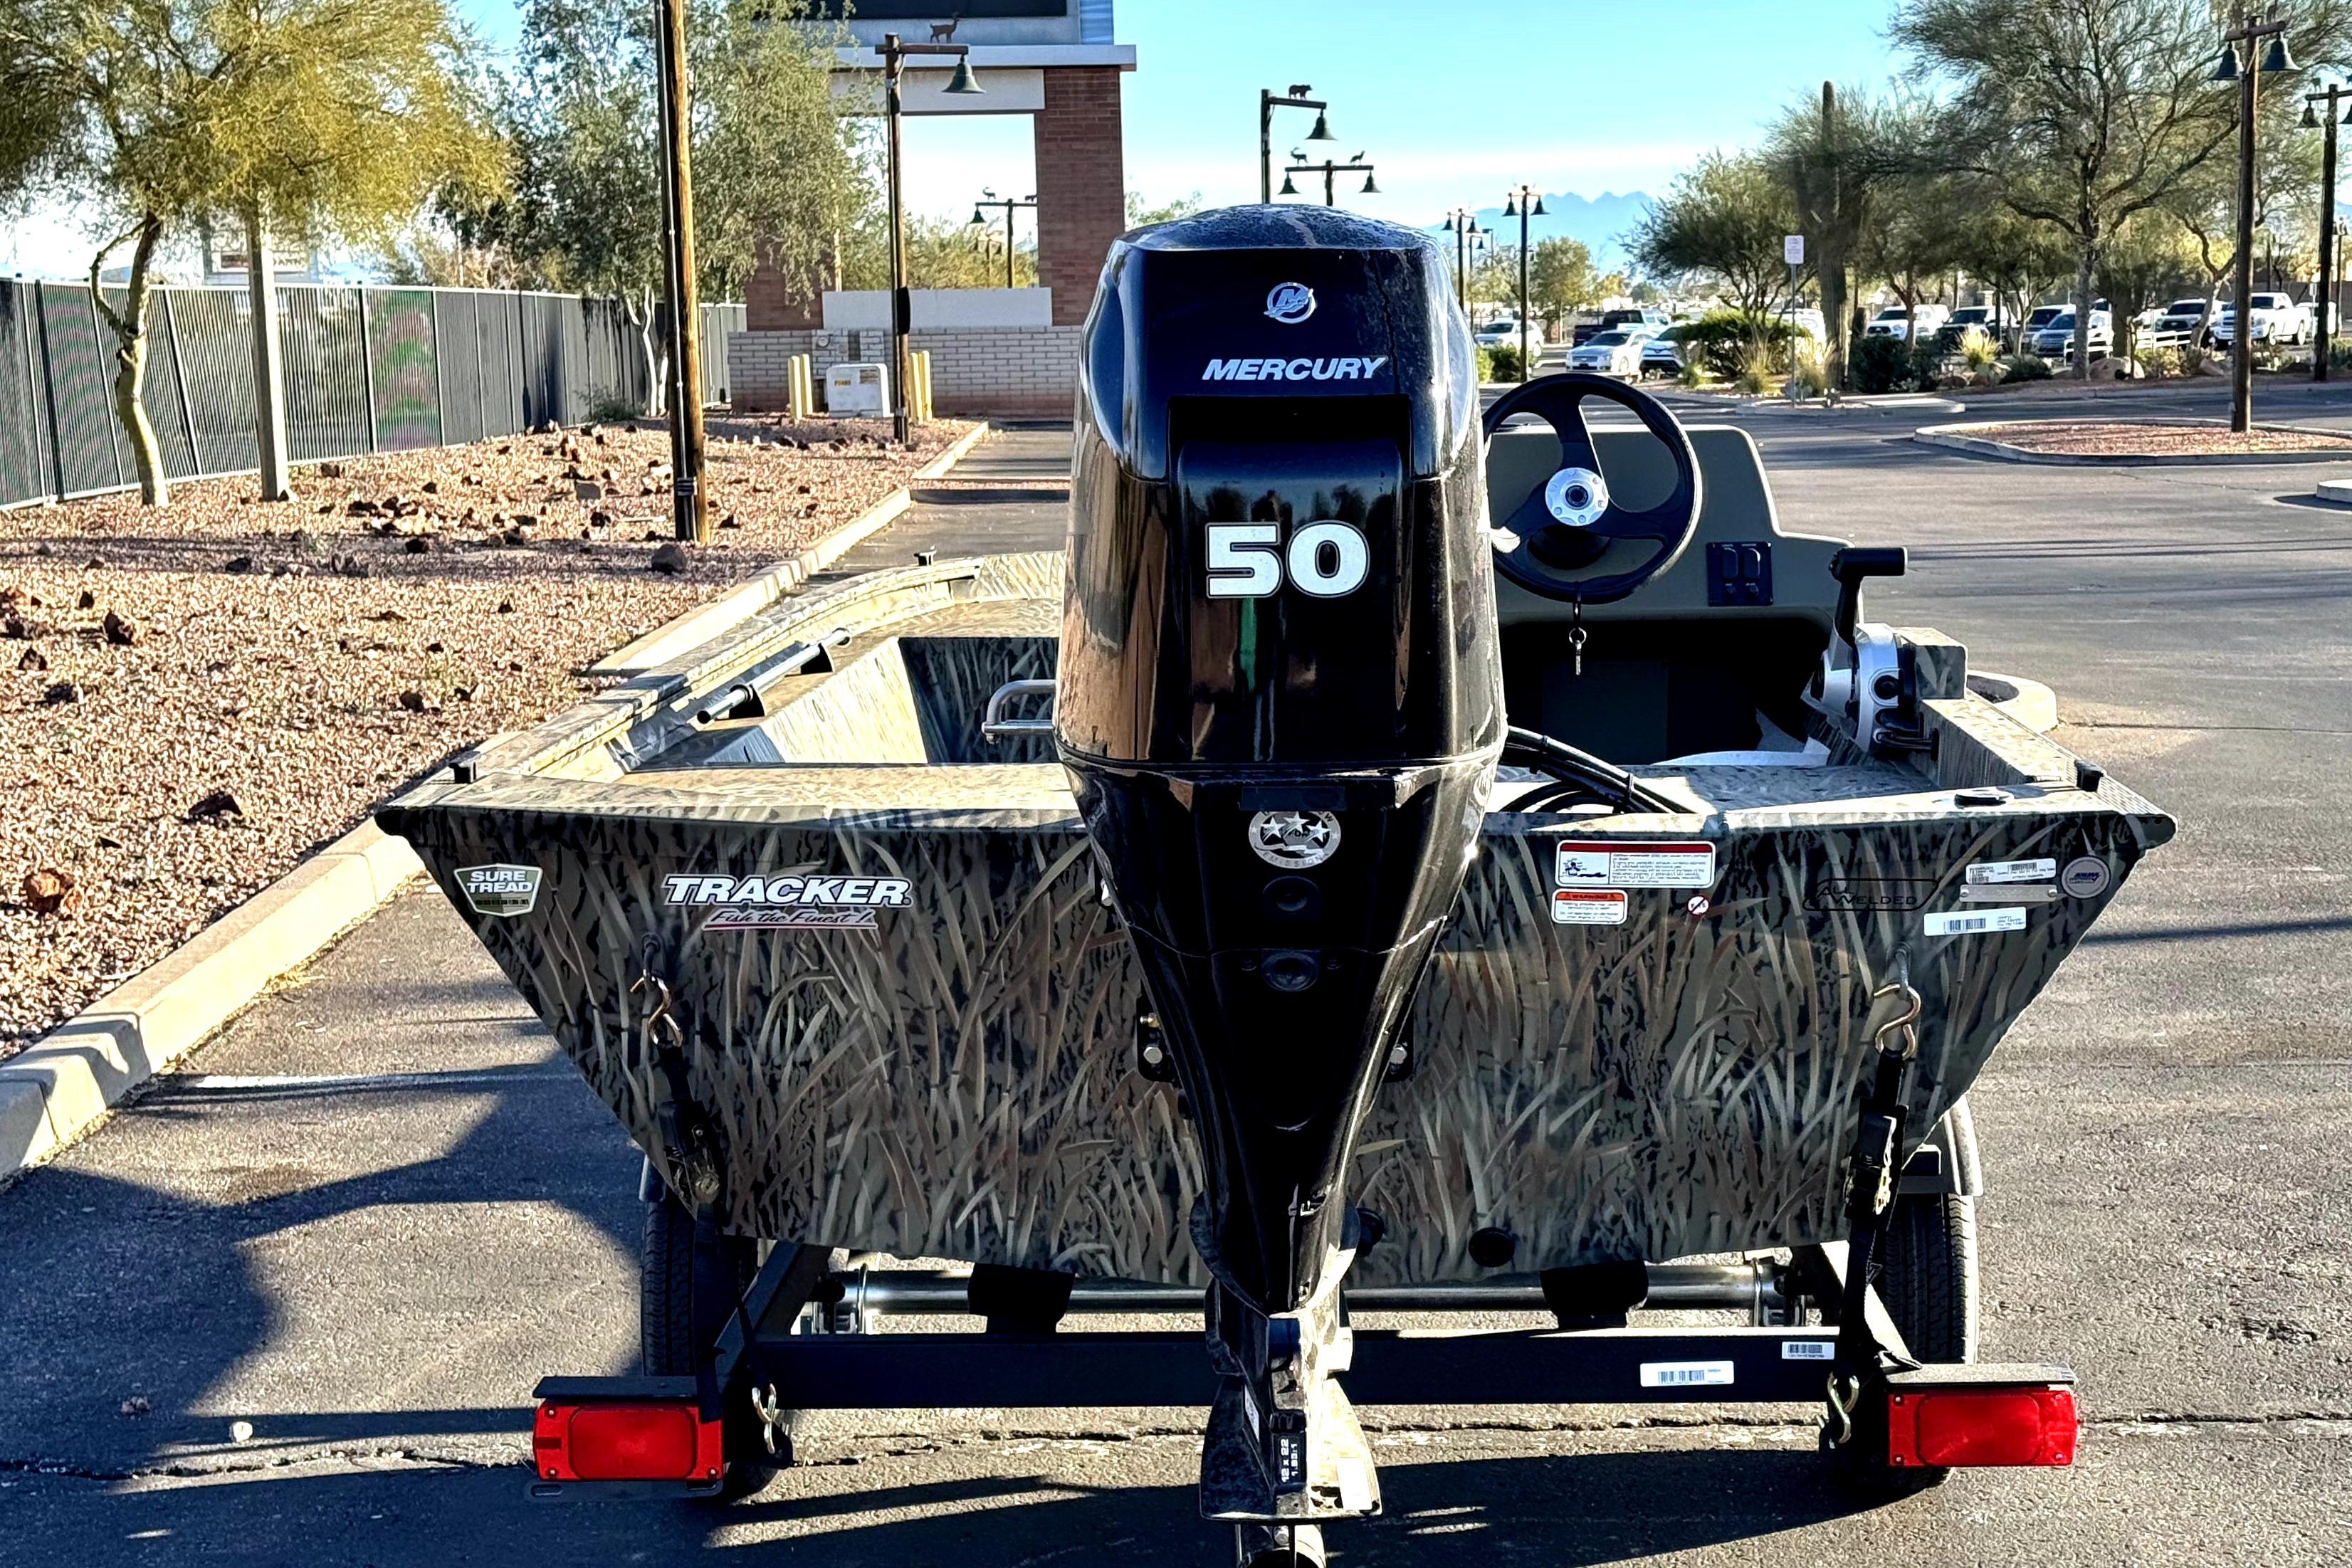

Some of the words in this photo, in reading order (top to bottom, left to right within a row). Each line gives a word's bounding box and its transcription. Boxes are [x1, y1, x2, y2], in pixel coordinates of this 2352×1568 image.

[1202, 357, 1387, 381] MERCURY
[1205, 520, 1370, 599] 50
[470, 870, 526, 882] SURE
[466, 882, 534, 893] TREAD
[666, 877, 909, 905] TRACKER
[1832, 895, 1918, 905] WELDED
[711, 910, 755, 922] Fish
[757, 910, 785, 922] the
[1281, 1438, 1289, 1456] 22
[1281, 1468, 1289, 1483] 12
